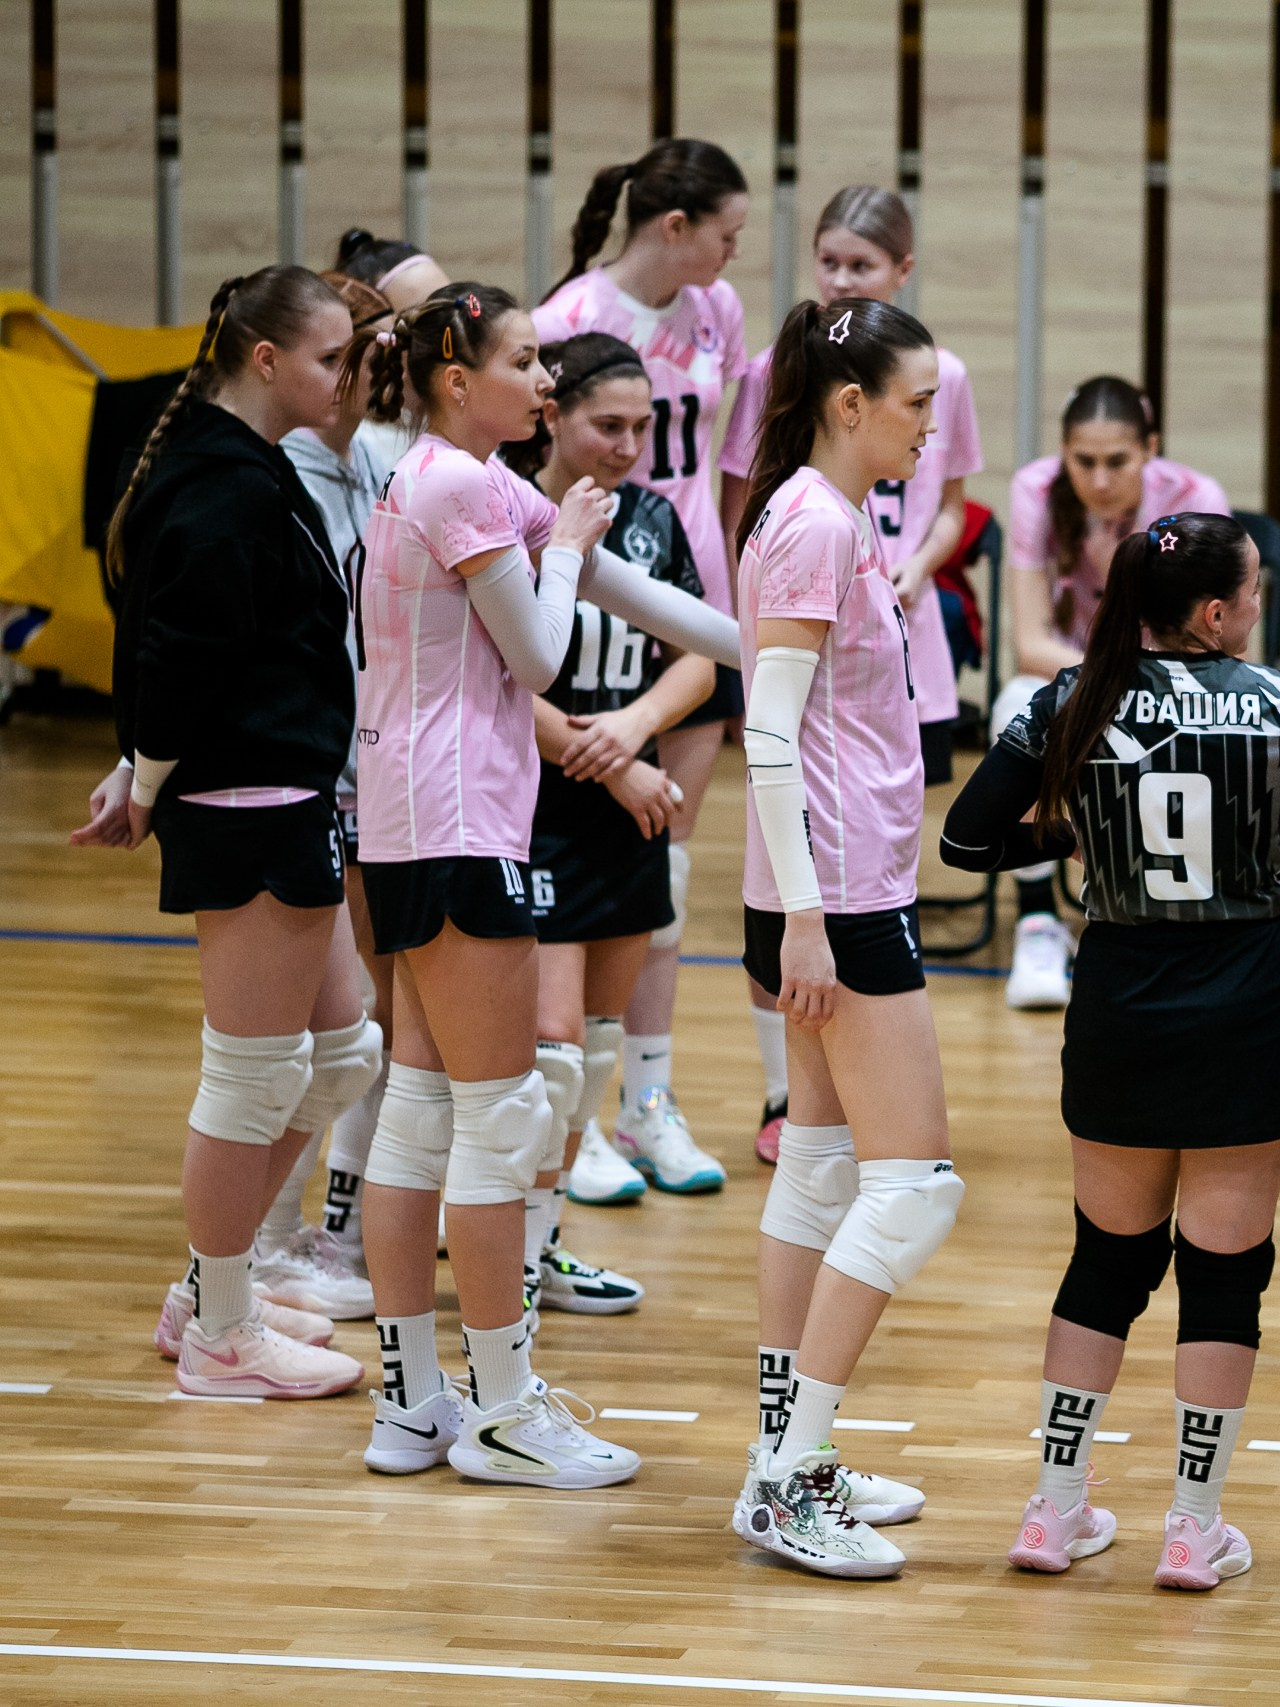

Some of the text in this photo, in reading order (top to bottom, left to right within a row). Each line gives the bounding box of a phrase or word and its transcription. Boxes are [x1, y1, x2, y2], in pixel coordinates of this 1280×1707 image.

[650, 394, 700, 480] 11
[571, 600, 646, 691] 16
[1114, 690, 1261, 726] УВАШИЯ
[1138, 772, 1214, 901] 9
[1043, 1391, 1097, 1467] ELITE
[1177, 1409, 1224, 1484] ELITE
